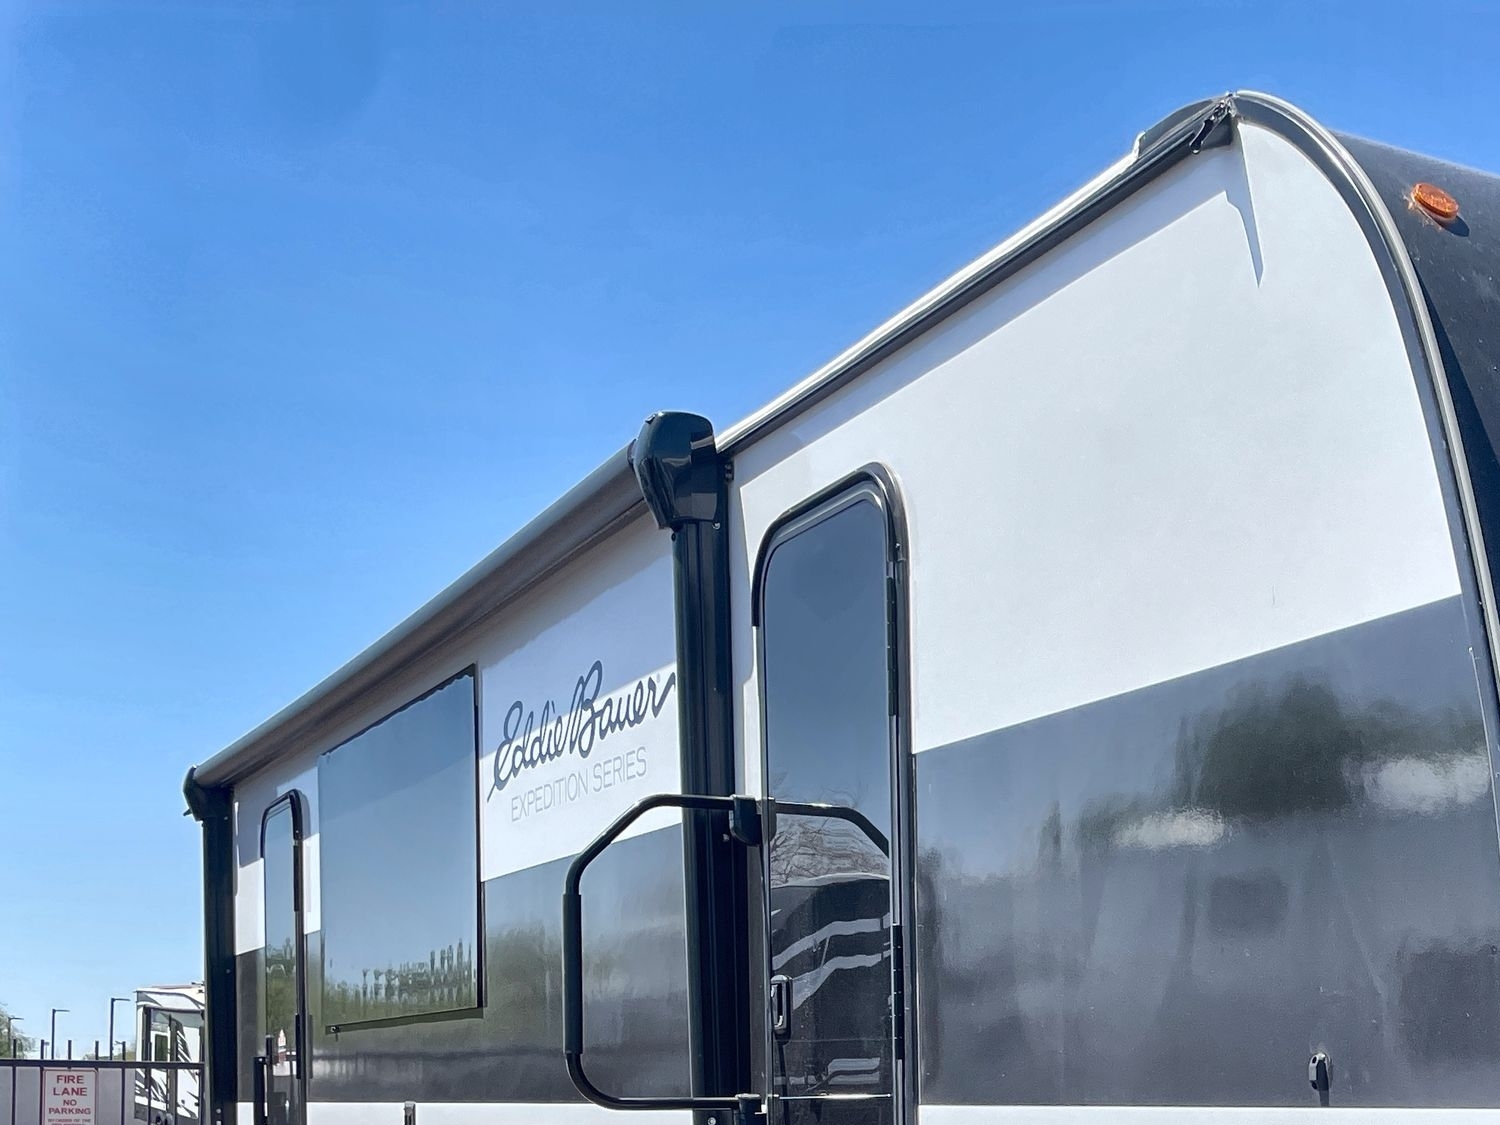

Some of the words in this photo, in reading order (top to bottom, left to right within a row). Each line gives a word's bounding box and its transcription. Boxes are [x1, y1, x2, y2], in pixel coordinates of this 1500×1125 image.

[487, 700, 574, 804] Eddie
[569, 660, 676, 759] Bauer
[511, 771, 589, 822] EXPEDITION
[593, 746, 647, 793] SERIES
[56, 1075, 84, 1084] FIRE
[53, 1087, 87, 1096] LANE
[48, 1107, 91, 1115] PARKING
